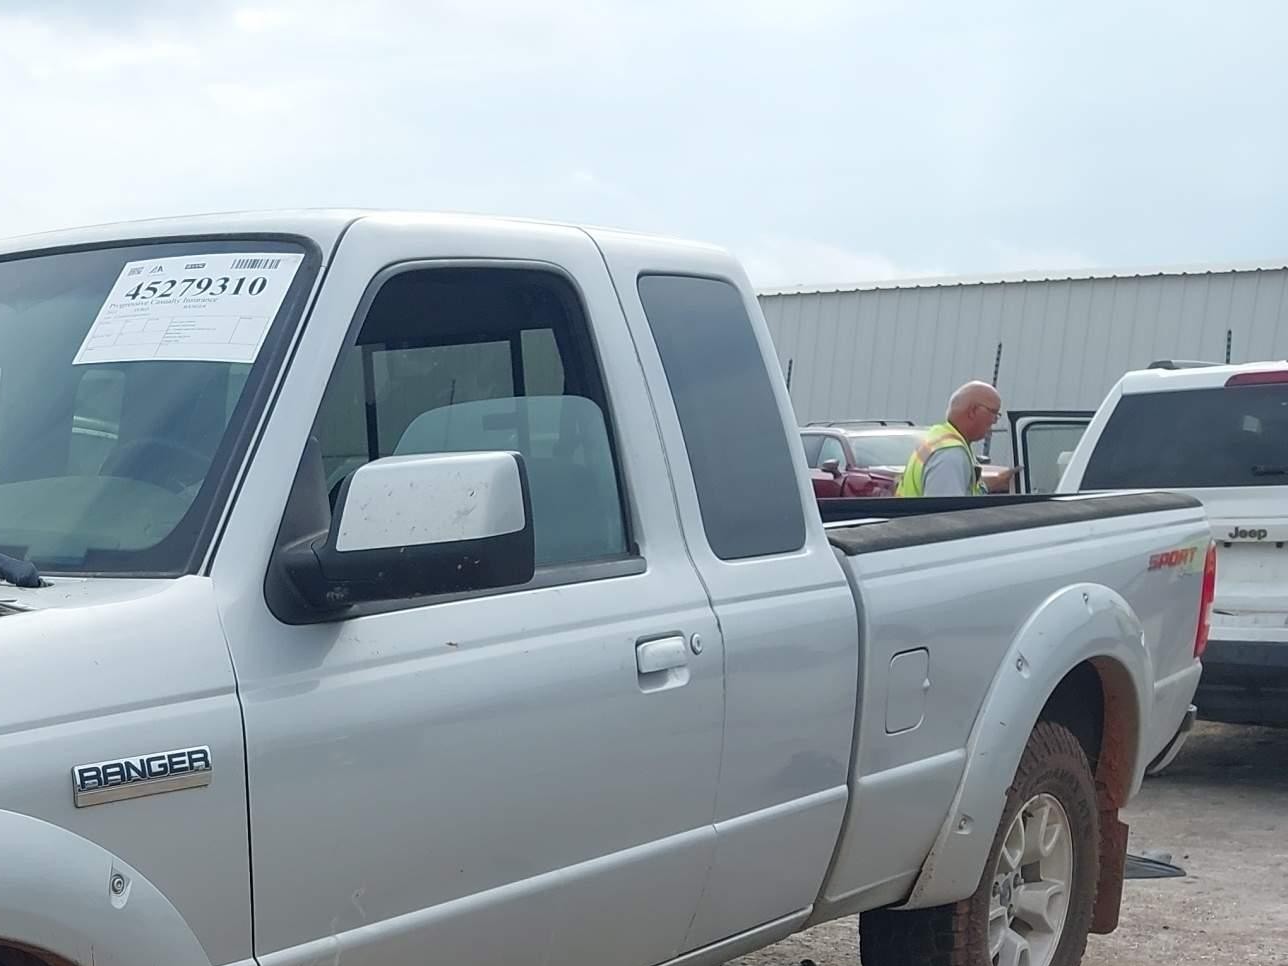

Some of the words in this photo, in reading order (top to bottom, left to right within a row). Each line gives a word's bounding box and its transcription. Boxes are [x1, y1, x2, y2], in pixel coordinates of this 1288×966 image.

[125, 277, 268, 300] 45279310
[1229, 527, 1268, 540] Jeep
[1148, 547, 1197, 571] SPORT
[78, 748, 210, 790] RANGER
